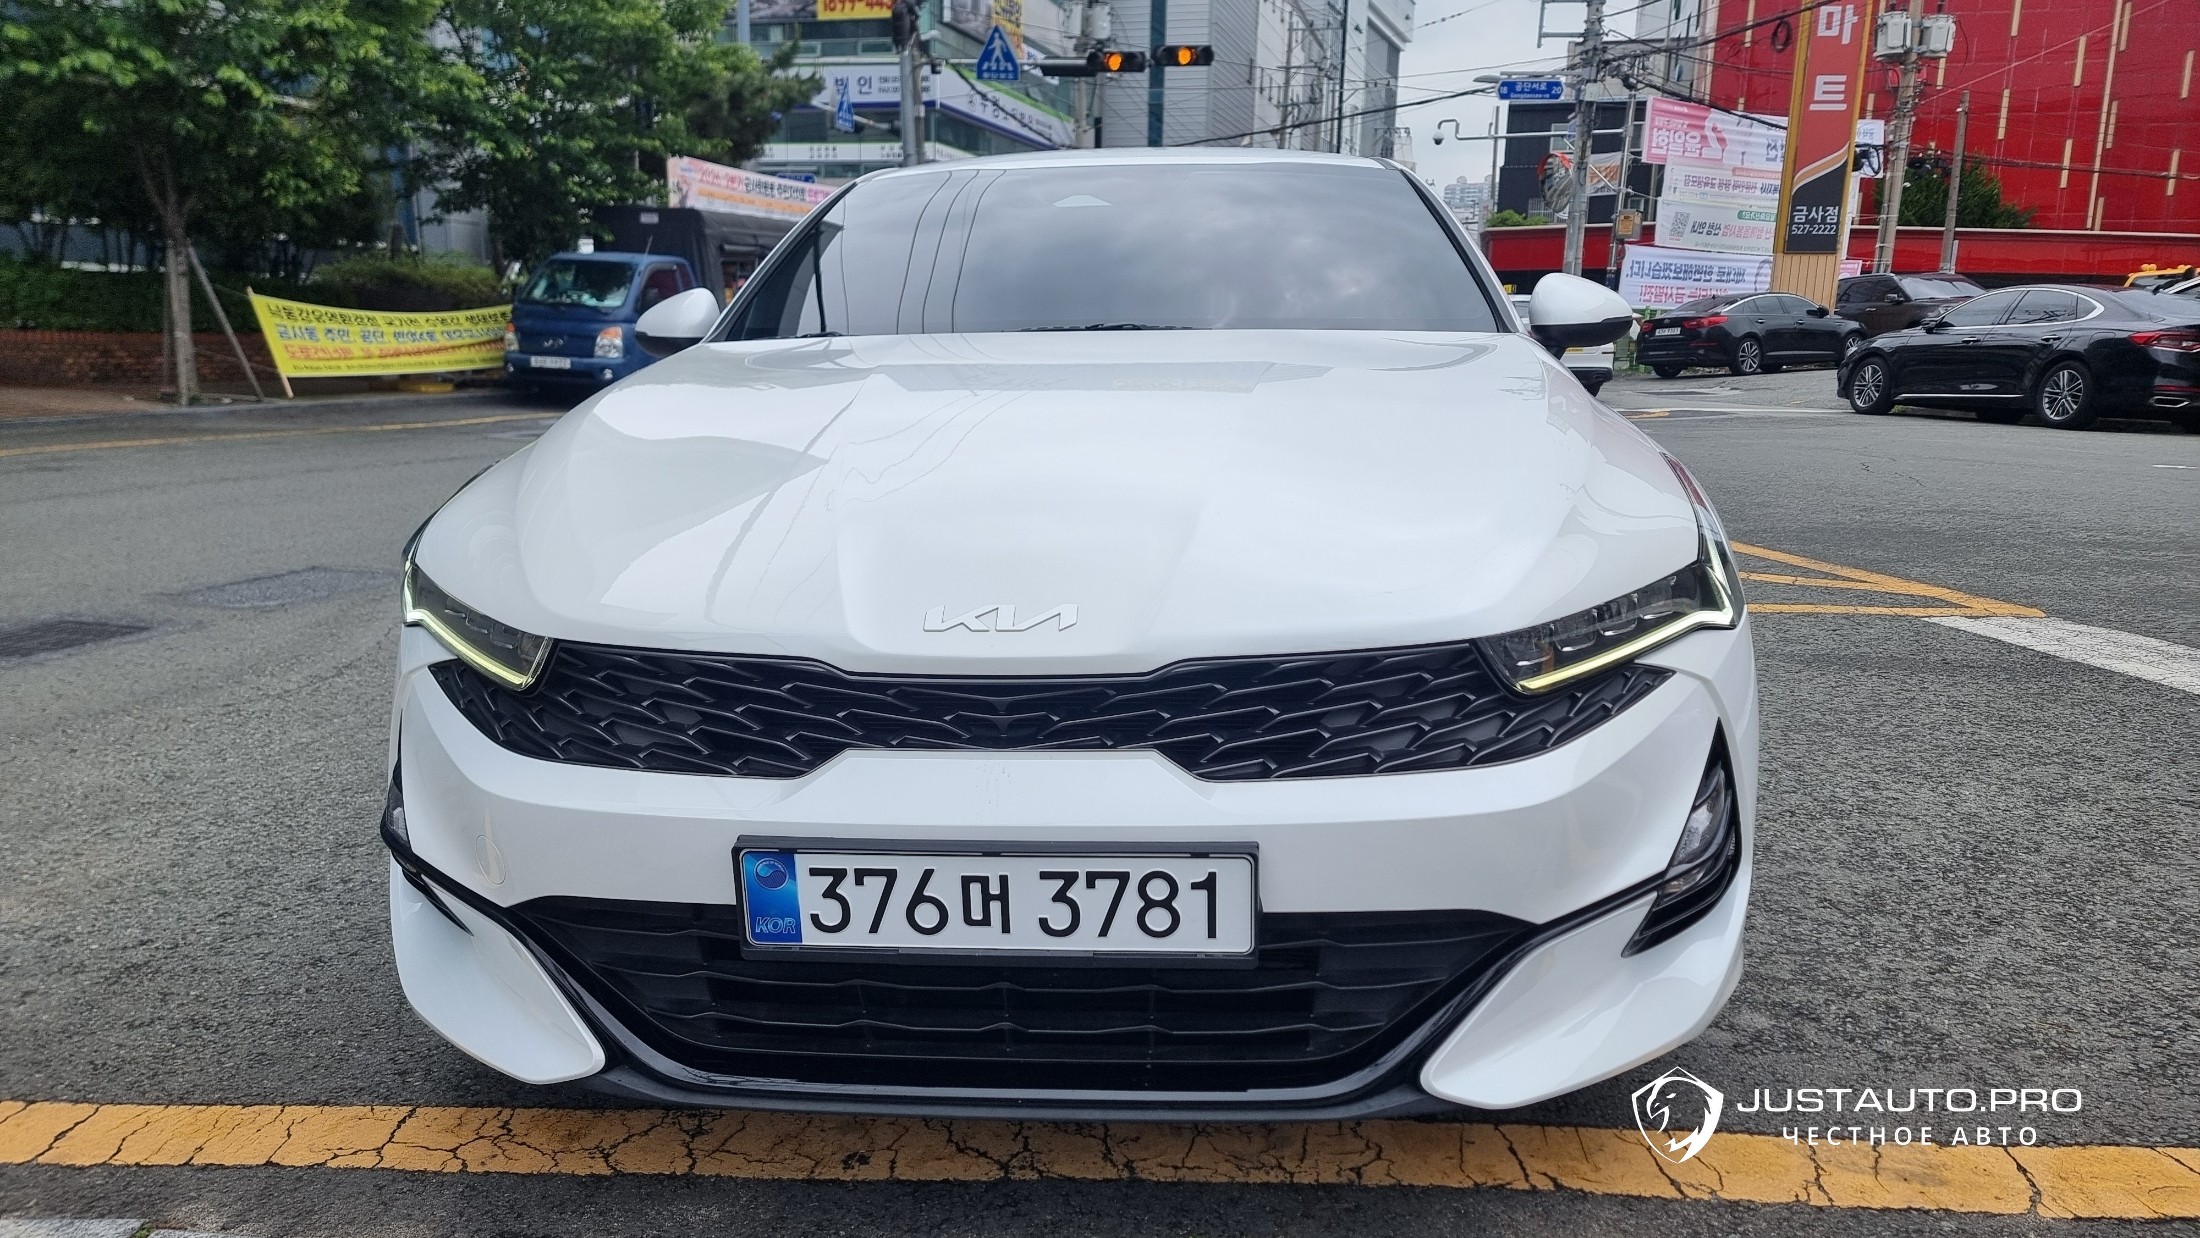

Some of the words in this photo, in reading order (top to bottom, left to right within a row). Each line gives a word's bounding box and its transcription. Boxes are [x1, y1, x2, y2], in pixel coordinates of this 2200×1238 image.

[1515, 82, 1547, 91] 공단서로
[1551, 86, 1562, 94] 20
[1793, 205, 1839, 223] 금사점
[1791, 224, 1836, 235] 527-2222
[808, 866, 1012, 937] 376머
[1038, 870, 1218, 940] 3781
[755, 916, 796, 934] KOR
